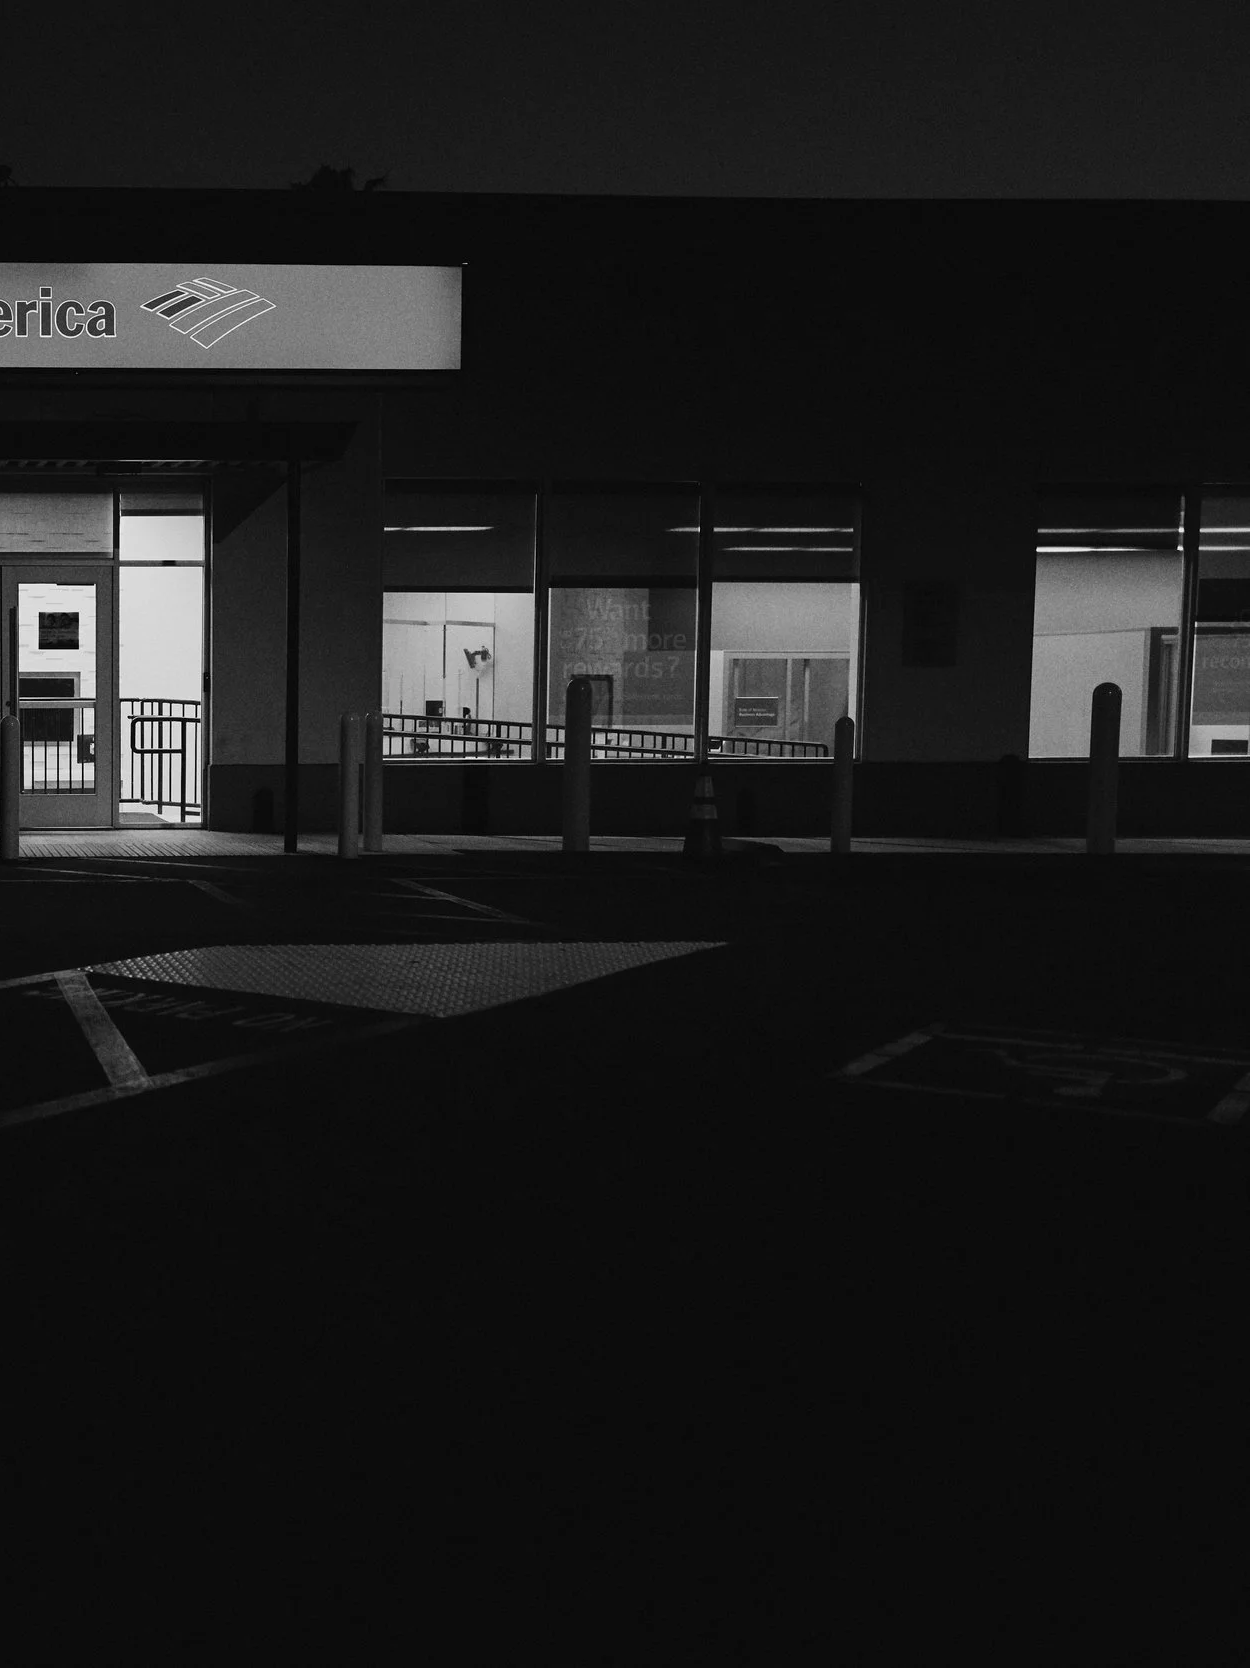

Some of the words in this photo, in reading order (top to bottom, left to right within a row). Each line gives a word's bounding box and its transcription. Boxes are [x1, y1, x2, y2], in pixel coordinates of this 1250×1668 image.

[586, 599, 651, 620] Want
[624, 633, 687, 650] more
[563, 656, 680, 678] rewards?
